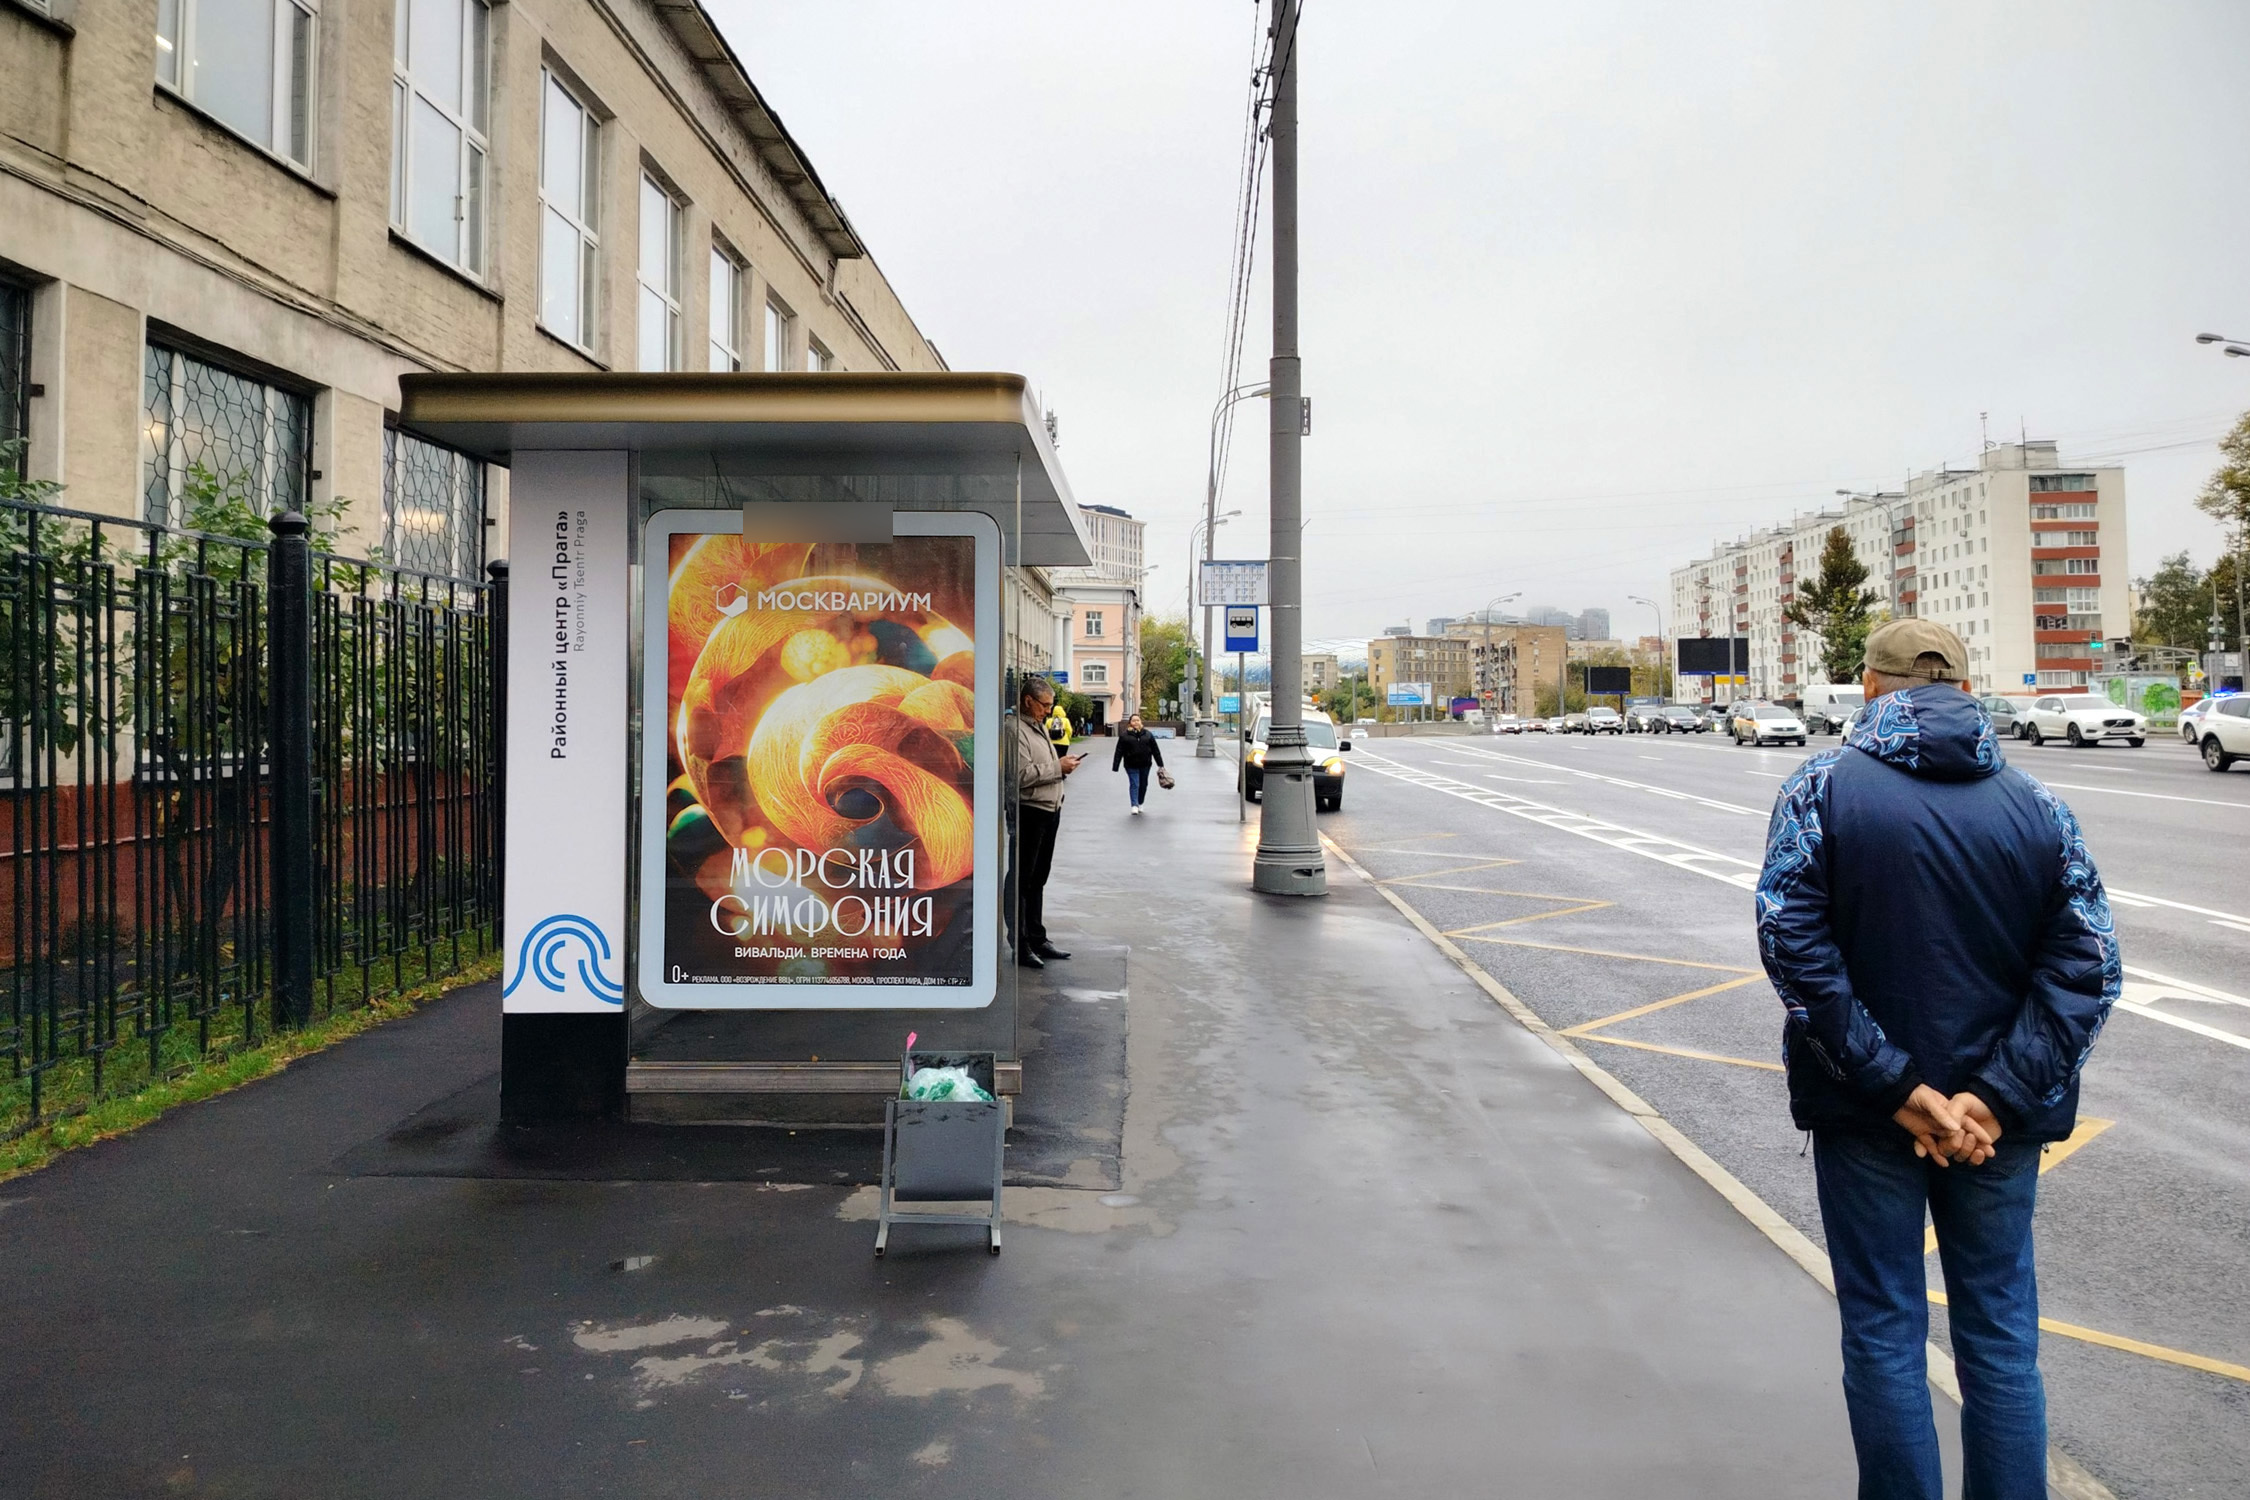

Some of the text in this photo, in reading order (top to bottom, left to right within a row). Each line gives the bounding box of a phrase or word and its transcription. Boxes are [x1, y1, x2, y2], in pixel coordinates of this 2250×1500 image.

[573, 510, 588, 652] Rayonniy Tsentr Praga
[757, 591, 932, 612] МОСКВАРИУМ
[551, 510, 571, 759] Районный центр «Прага»
[729, 847, 915, 889] МОРСКАЯ
[710, 894, 933, 938] СИМФОНИЯ
[734, 947, 907, 960] ВИВАЛЬДИ. ВРЕМЕНА ГОДА
[672, 965, 689, 983] 0+
[720, 975, 732, 984] ООО
[796, 976, 811, 984] ОГРН
[876, 976, 905, 985] ПРОСПЕКТ
[923, 976, 936, 985] ДОМ
